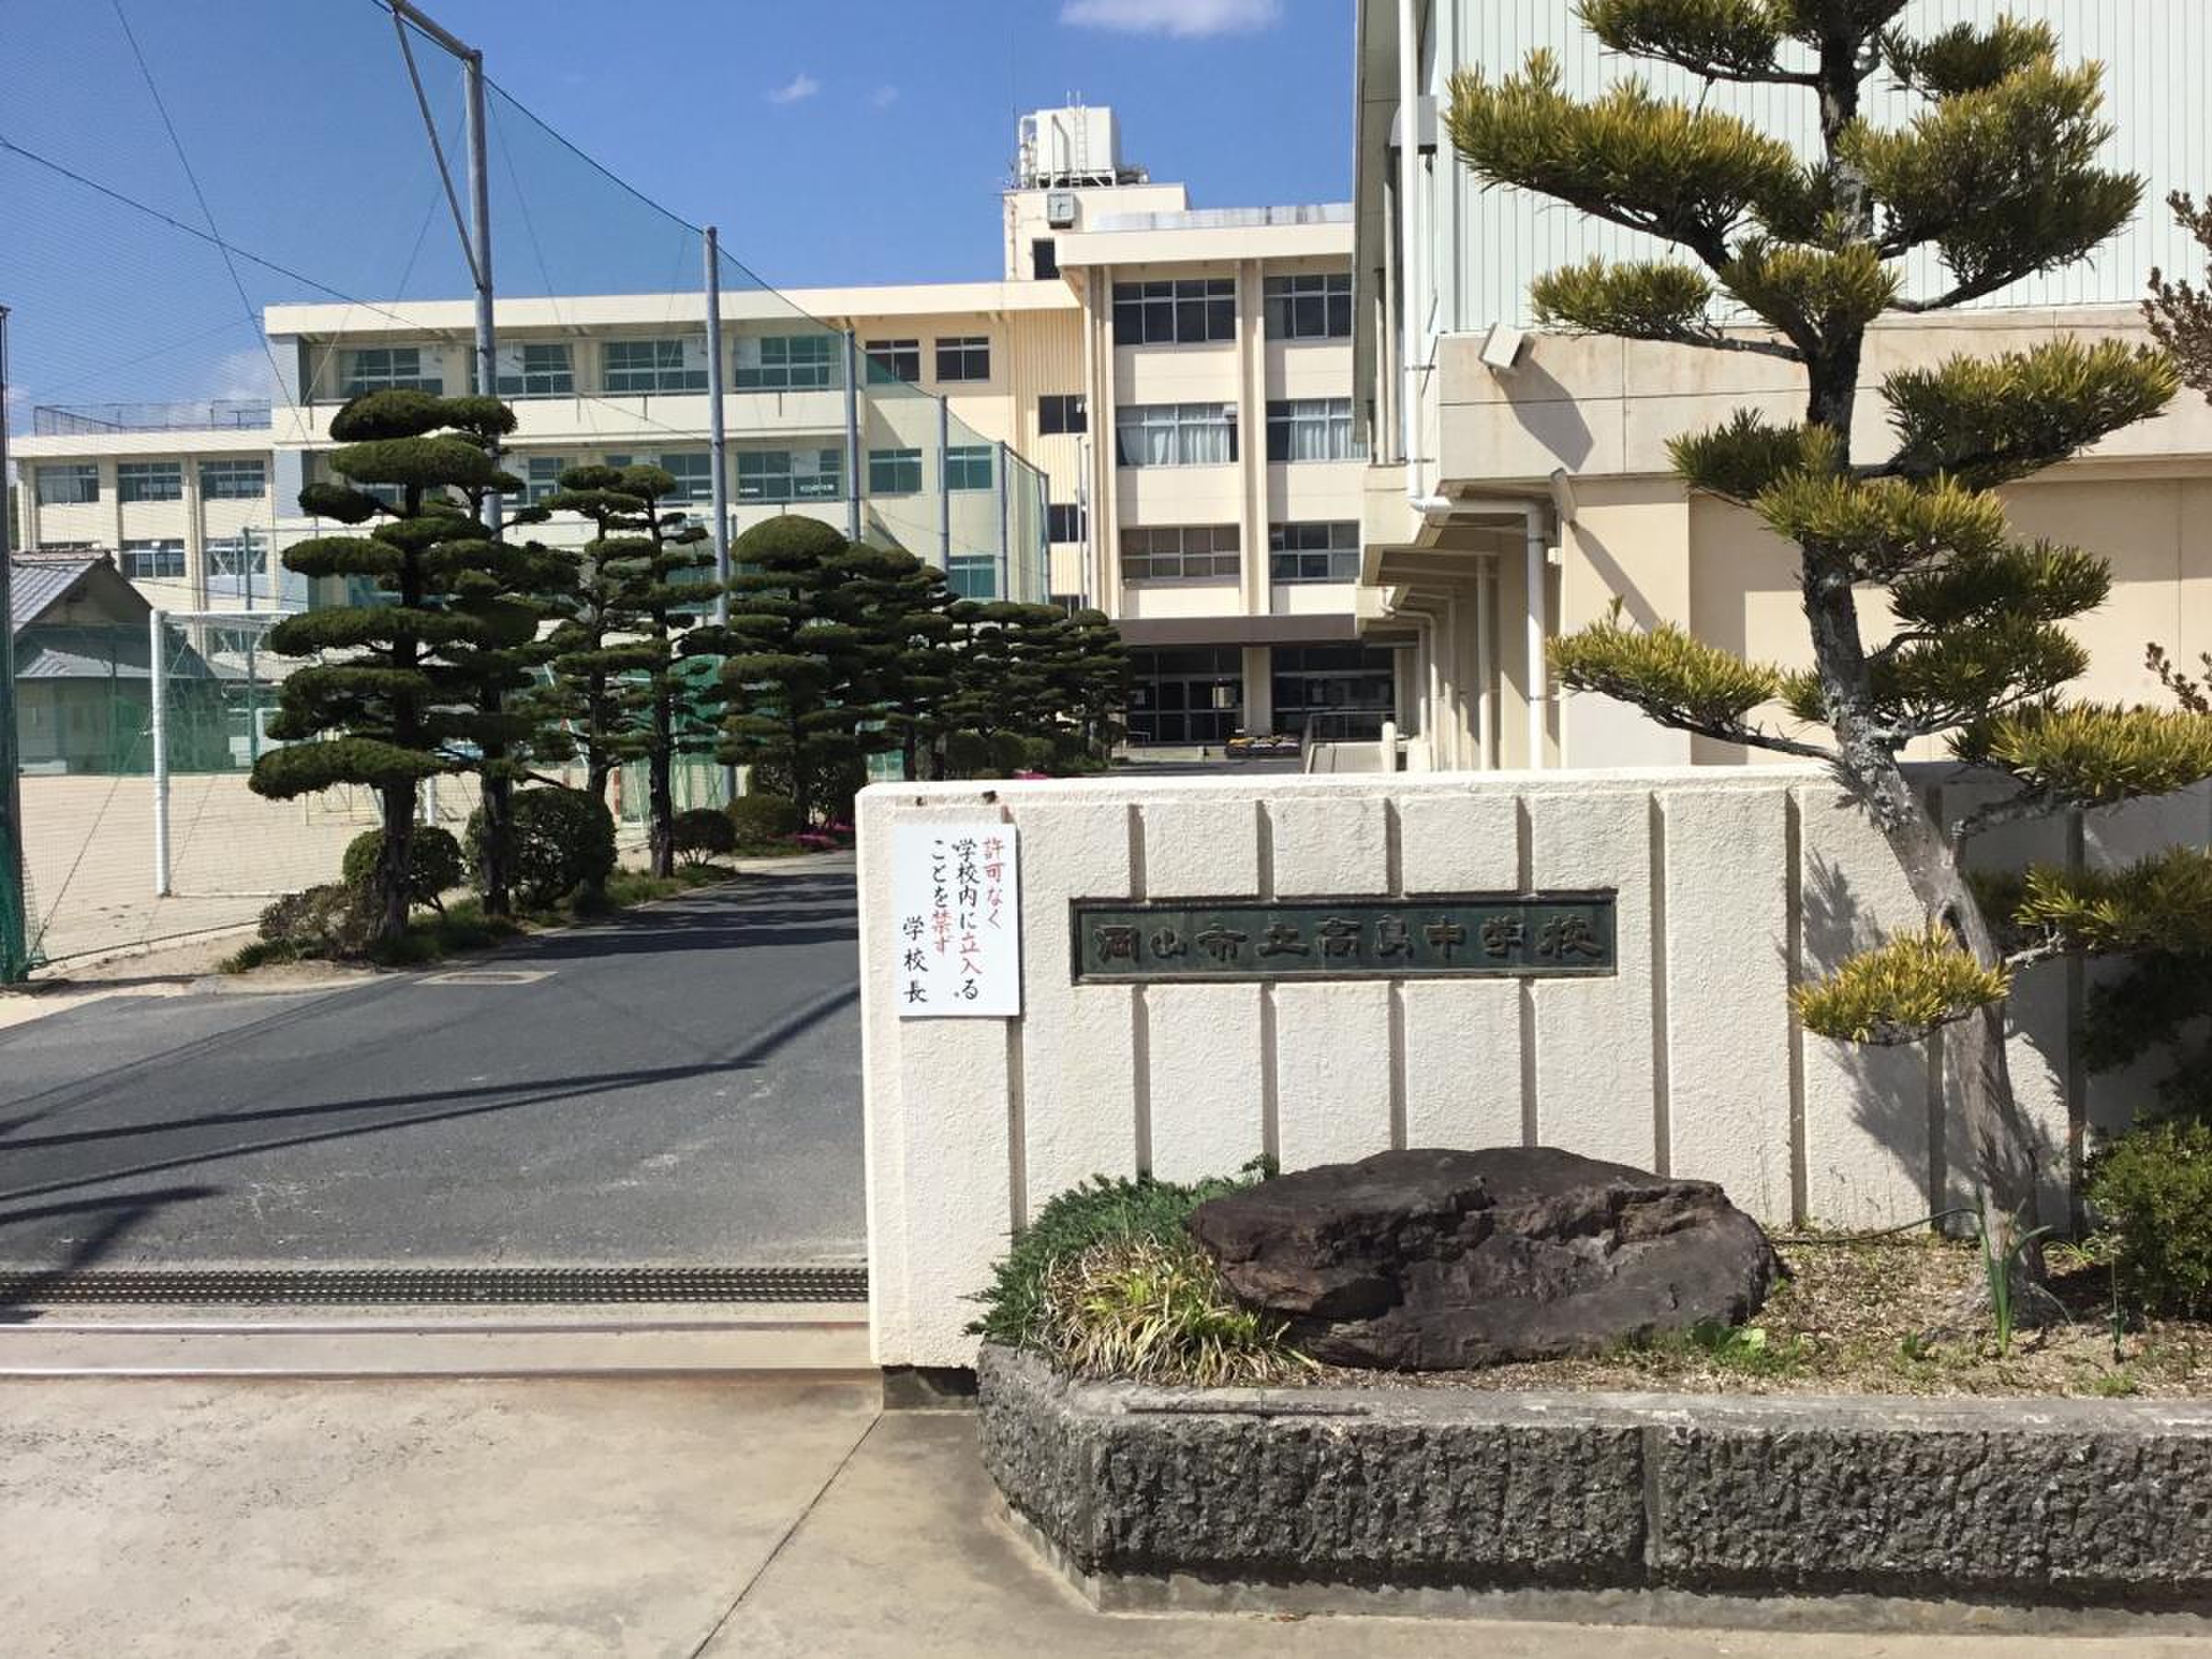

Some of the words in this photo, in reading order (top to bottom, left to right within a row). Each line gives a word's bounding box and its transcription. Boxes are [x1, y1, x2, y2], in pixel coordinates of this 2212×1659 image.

[983, 837, 1005, 929] 許可なく
[902, 915, 929, 1004] 学校長
[1092, 914, 1604, 962] 岡山市立高島中学校
